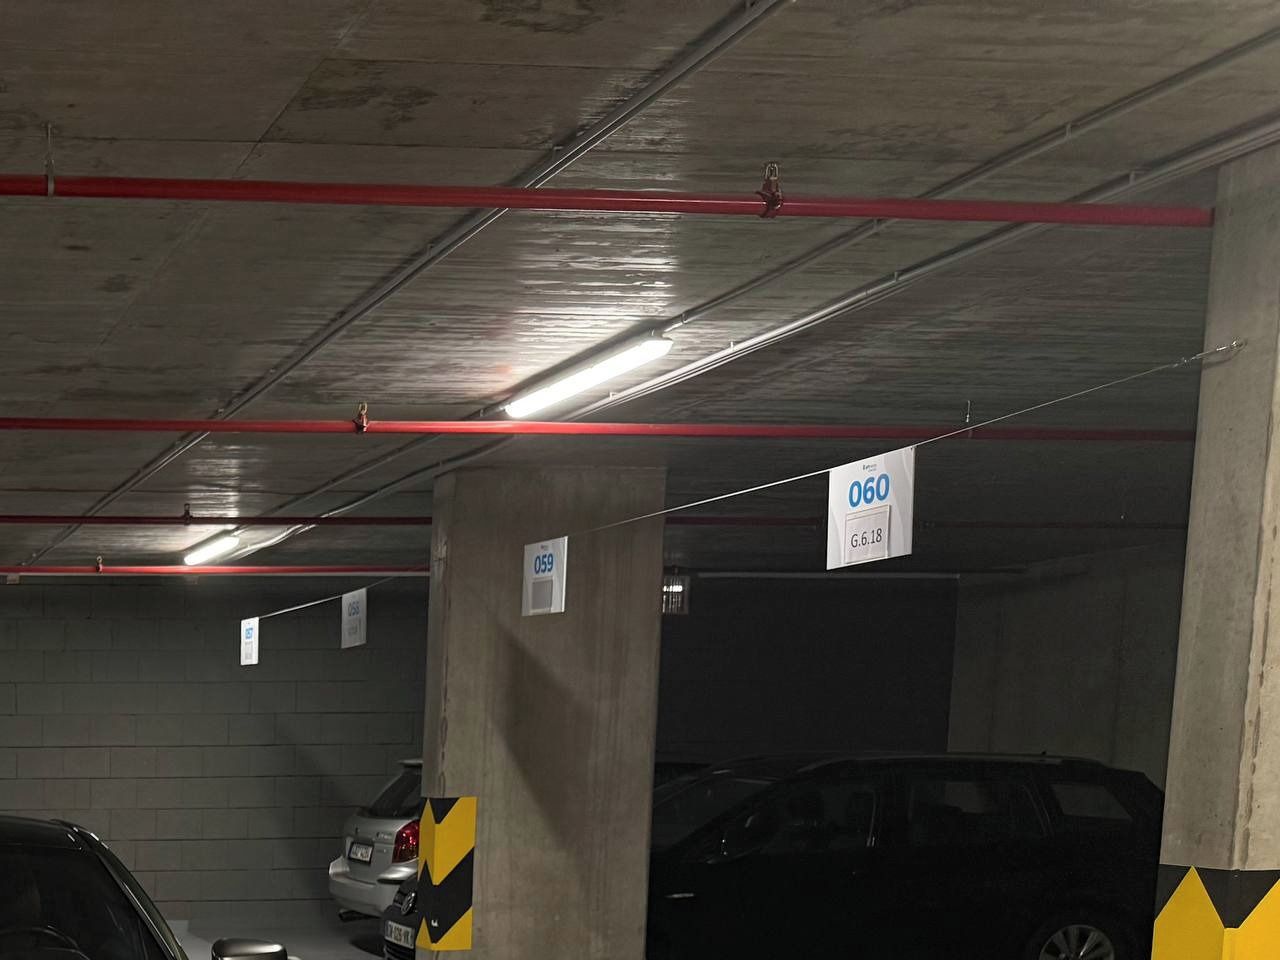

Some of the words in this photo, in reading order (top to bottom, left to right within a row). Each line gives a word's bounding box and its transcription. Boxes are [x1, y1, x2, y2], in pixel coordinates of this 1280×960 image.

[848, 473, 890, 508] 060
[850, 528, 883, 548] G.6.18
[534, 553, 554, 574] 059
